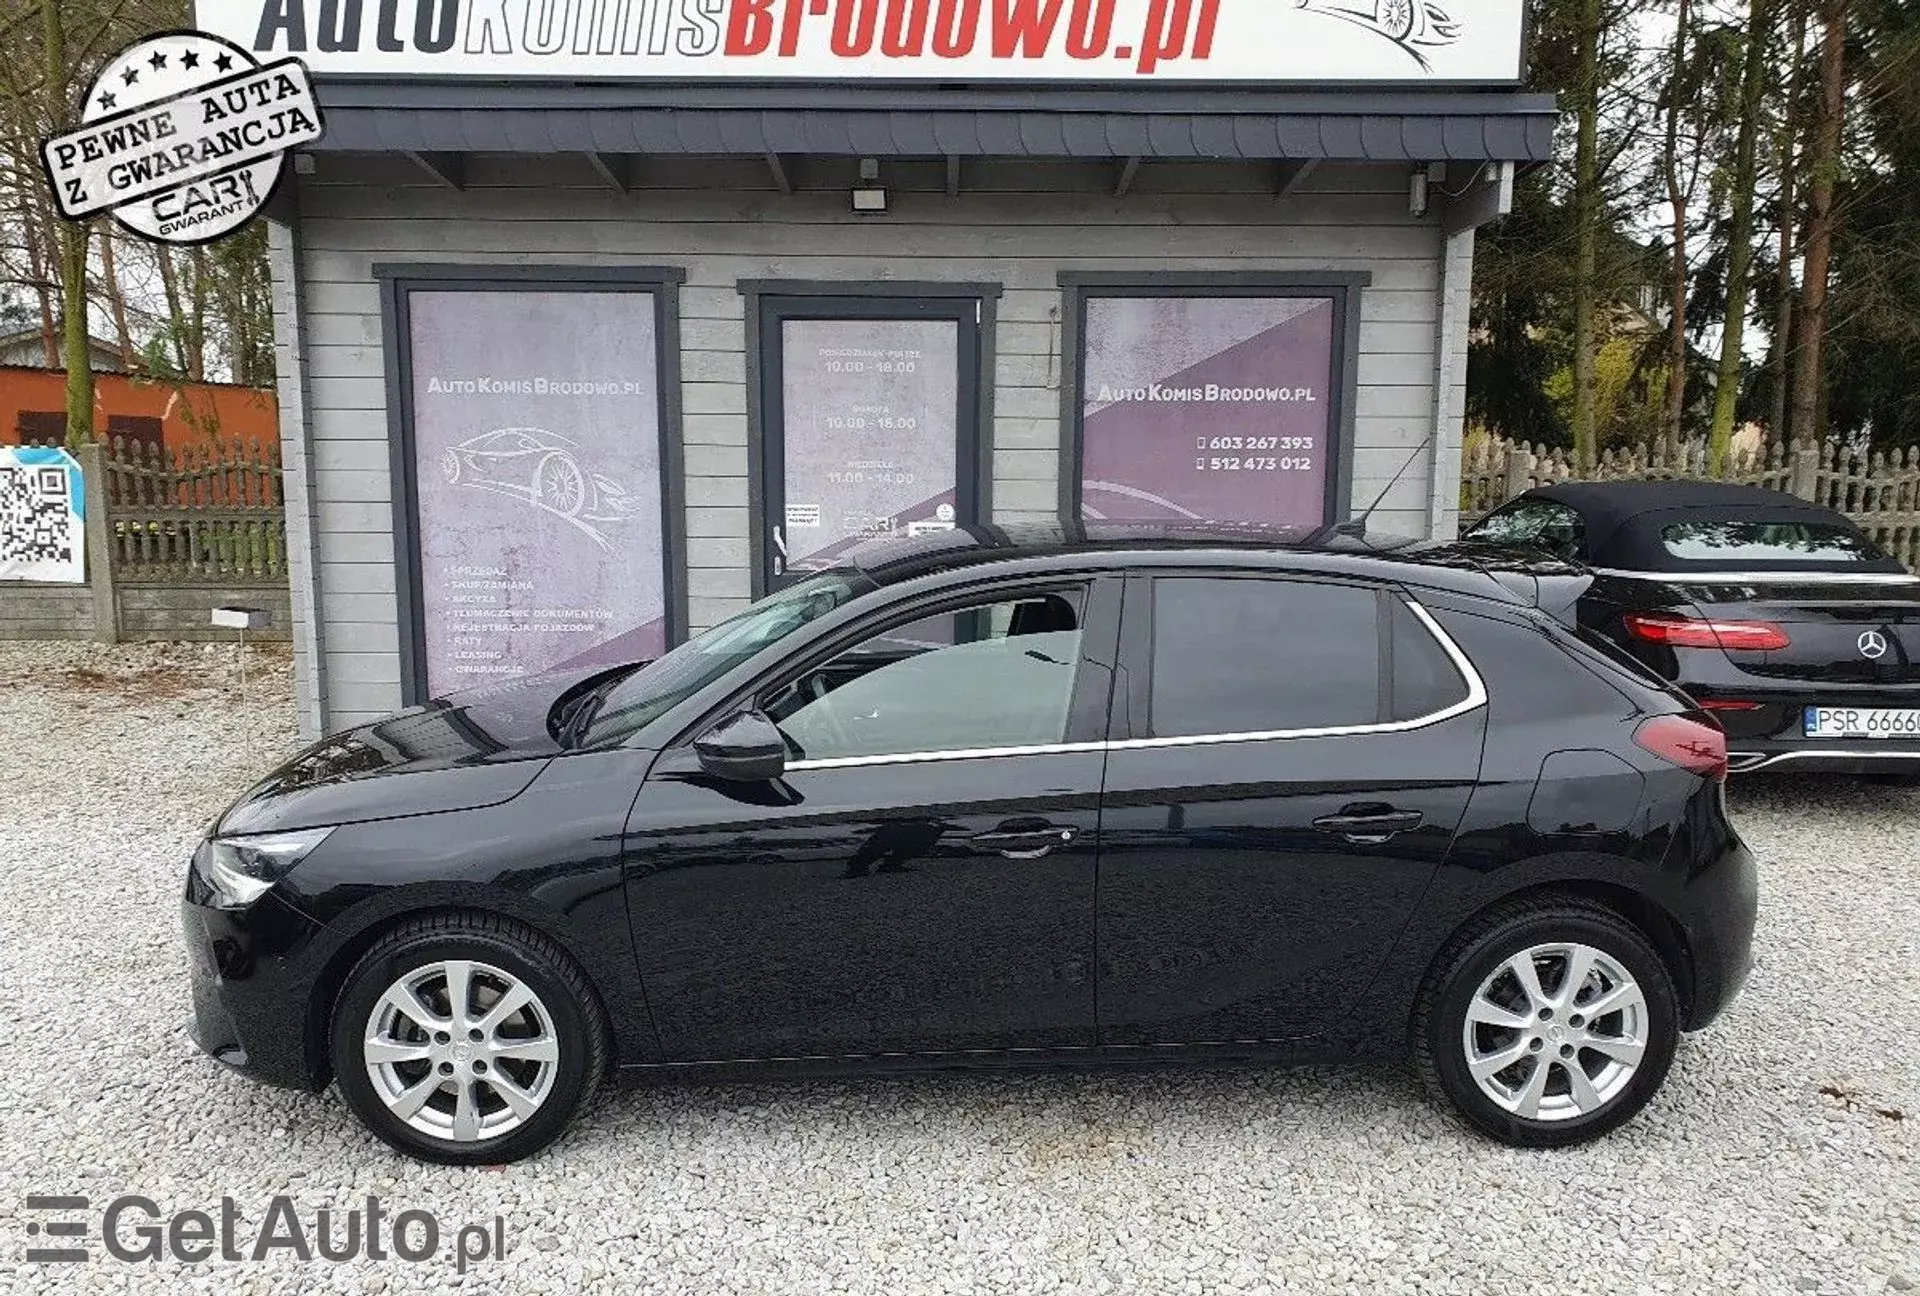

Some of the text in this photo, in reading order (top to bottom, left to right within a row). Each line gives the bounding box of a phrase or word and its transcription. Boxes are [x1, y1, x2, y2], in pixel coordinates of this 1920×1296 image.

[826, 361, 864, 373] 10.00
[876, 361, 915, 373] 18.00
[826, 417, 865, 429] 10.00
[1209, 436, 1314, 450] 603 267 393
[1209, 457, 1312, 470] 512 473 012
[827, 471, 864, 483] 11.00
[453, 636, 482, 647] RATY
[454, 651, 502, 660] LEASING
[1818, 710, 1859, 731] PSR
[1866, 710, 1920, 732] 6666
